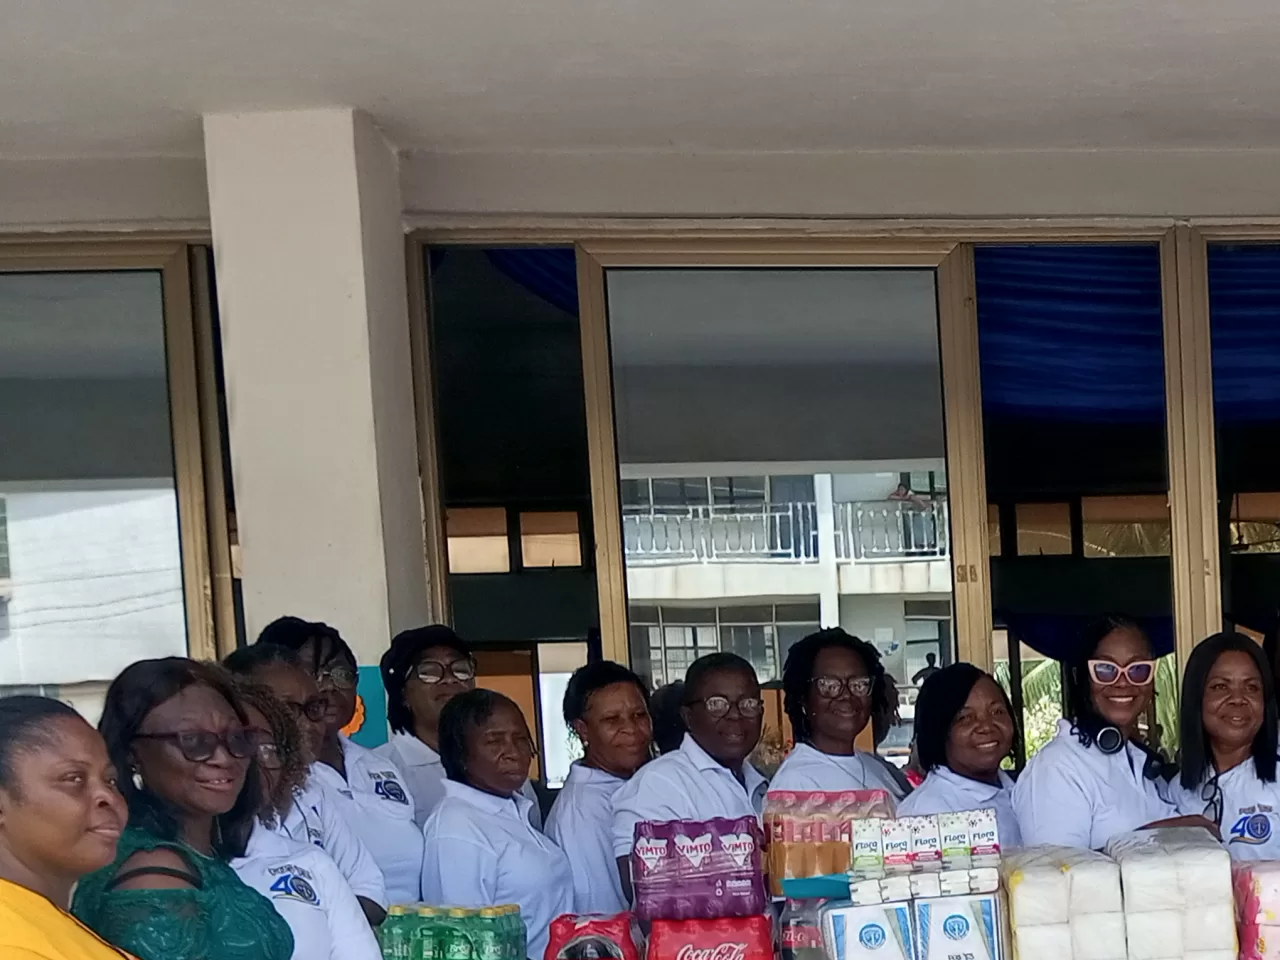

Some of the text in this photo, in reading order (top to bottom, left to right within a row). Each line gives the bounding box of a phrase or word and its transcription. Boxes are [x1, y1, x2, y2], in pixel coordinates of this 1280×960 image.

[944, 833, 966, 844] Flora
[973, 830, 995, 841] Flora
[855, 840, 878, 851] Flora
[885, 840, 908, 850] Flora
[914, 837, 937, 847] Flora
